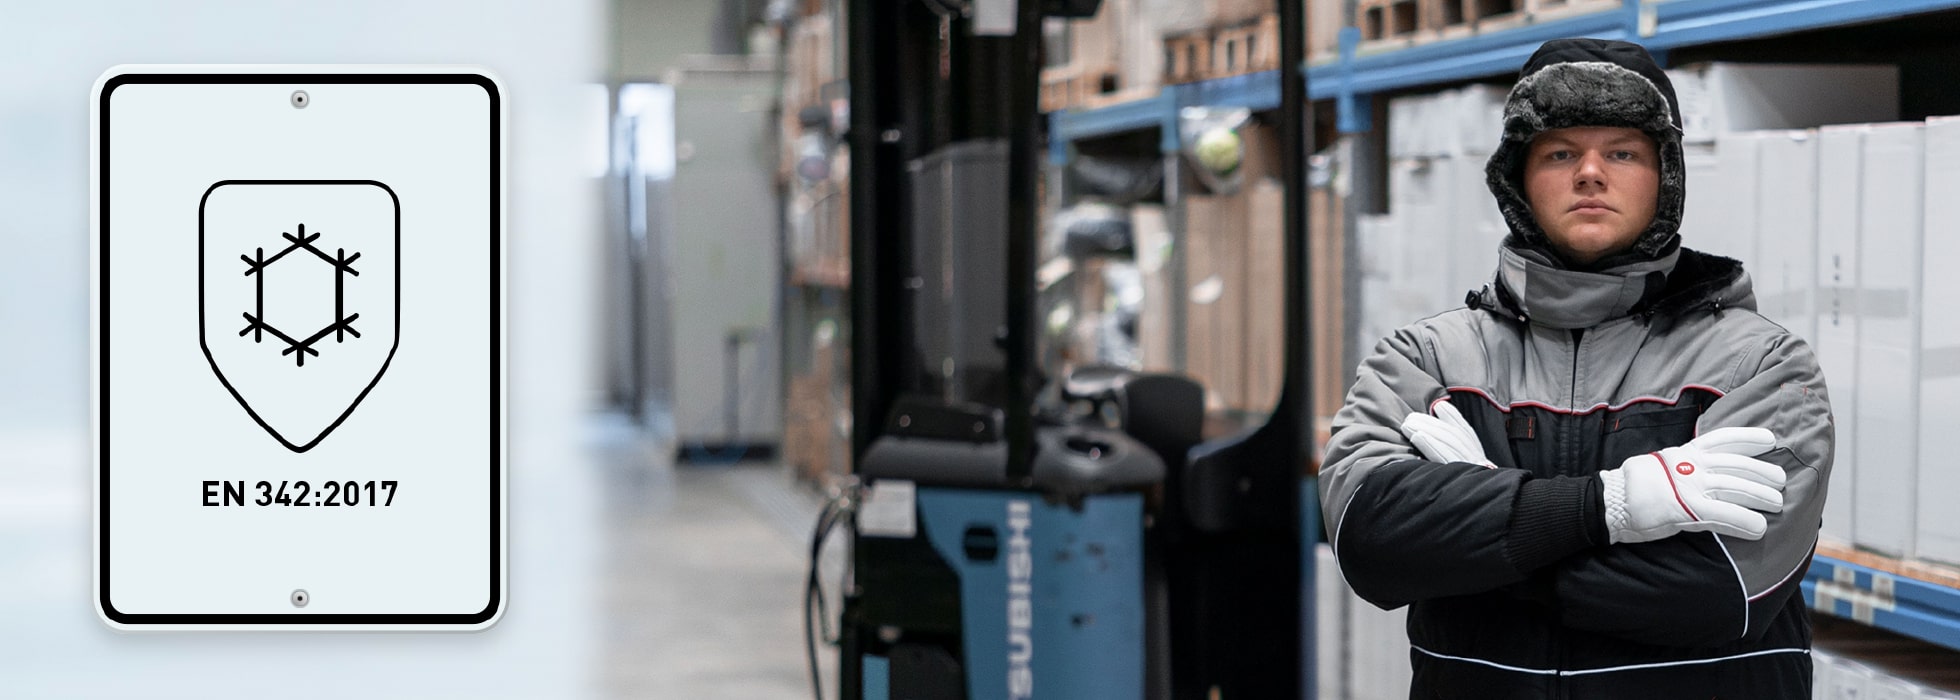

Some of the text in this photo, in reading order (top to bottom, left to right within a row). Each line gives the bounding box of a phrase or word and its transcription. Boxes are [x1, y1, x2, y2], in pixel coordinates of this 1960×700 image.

[202, 480, 398, 507] EN 342:2017
[1007, 502, 1032, 700] SUBISHI
